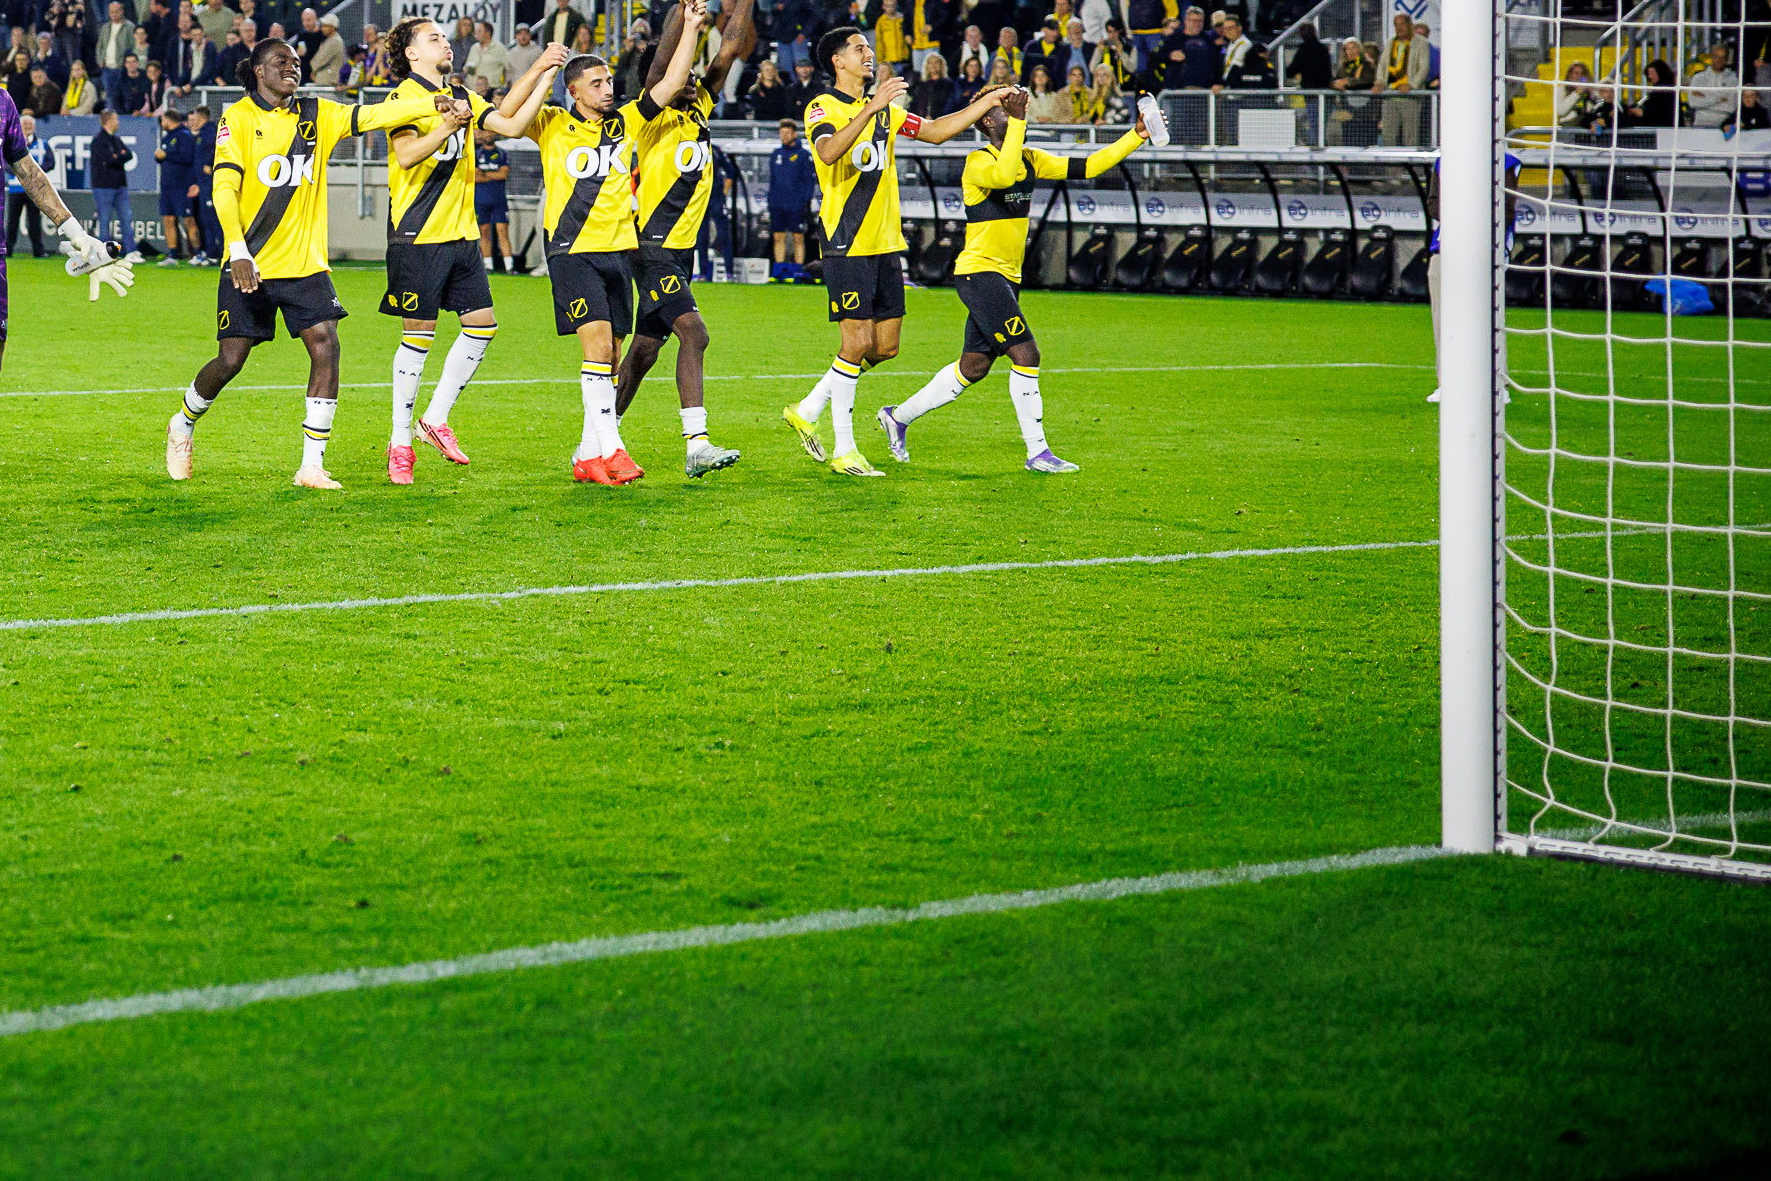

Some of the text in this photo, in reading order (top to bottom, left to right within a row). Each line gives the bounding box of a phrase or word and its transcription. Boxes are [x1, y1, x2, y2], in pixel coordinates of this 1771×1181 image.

[257, 153, 315, 188] OK
[565, 142, 628, 180] OK
[674, 140, 710, 173] OK
